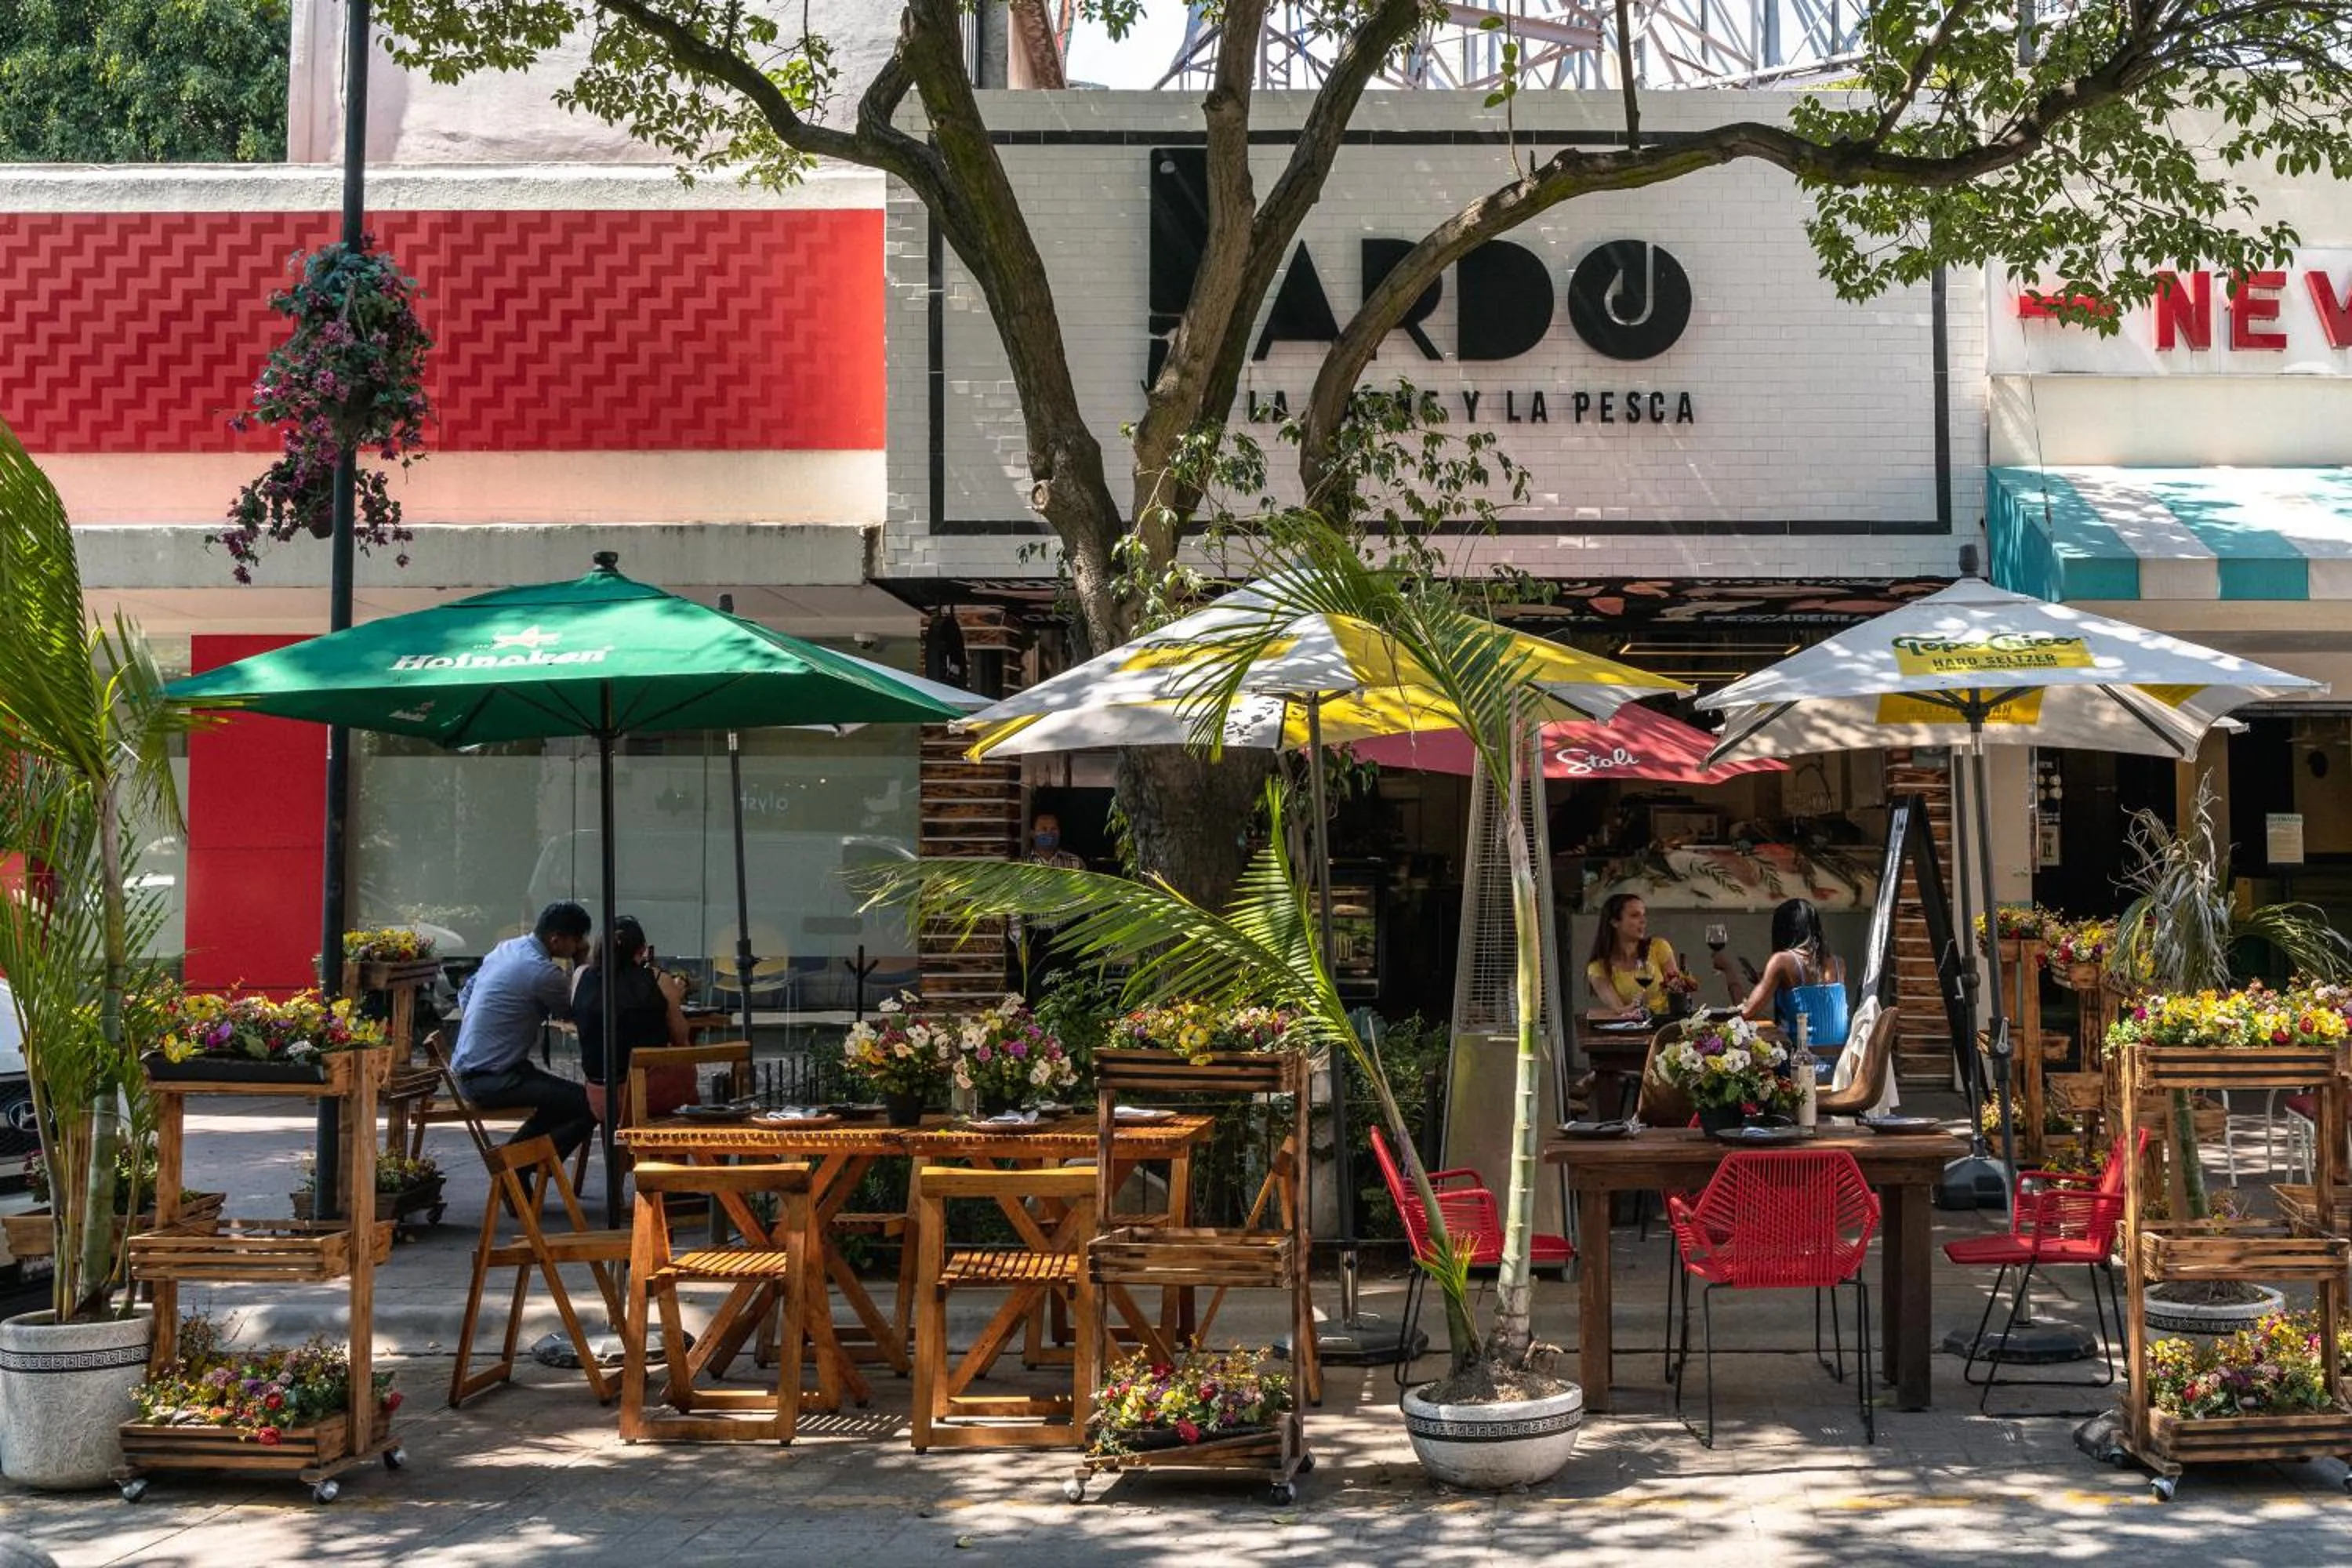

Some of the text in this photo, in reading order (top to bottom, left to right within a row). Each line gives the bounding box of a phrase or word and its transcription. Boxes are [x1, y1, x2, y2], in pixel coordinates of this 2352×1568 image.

[1462, 390, 1481, 423] Y
[1507, 390, 1548, 423] LA
[1573, 391, 1694, 423] PESCA
[389, 646, 614, 671] Heineken
[1933, 656, 1977, 667] HARD
[1985, 654, 2057, 665] SELTZER
[1555, 747, 1640, 775] Stoli
